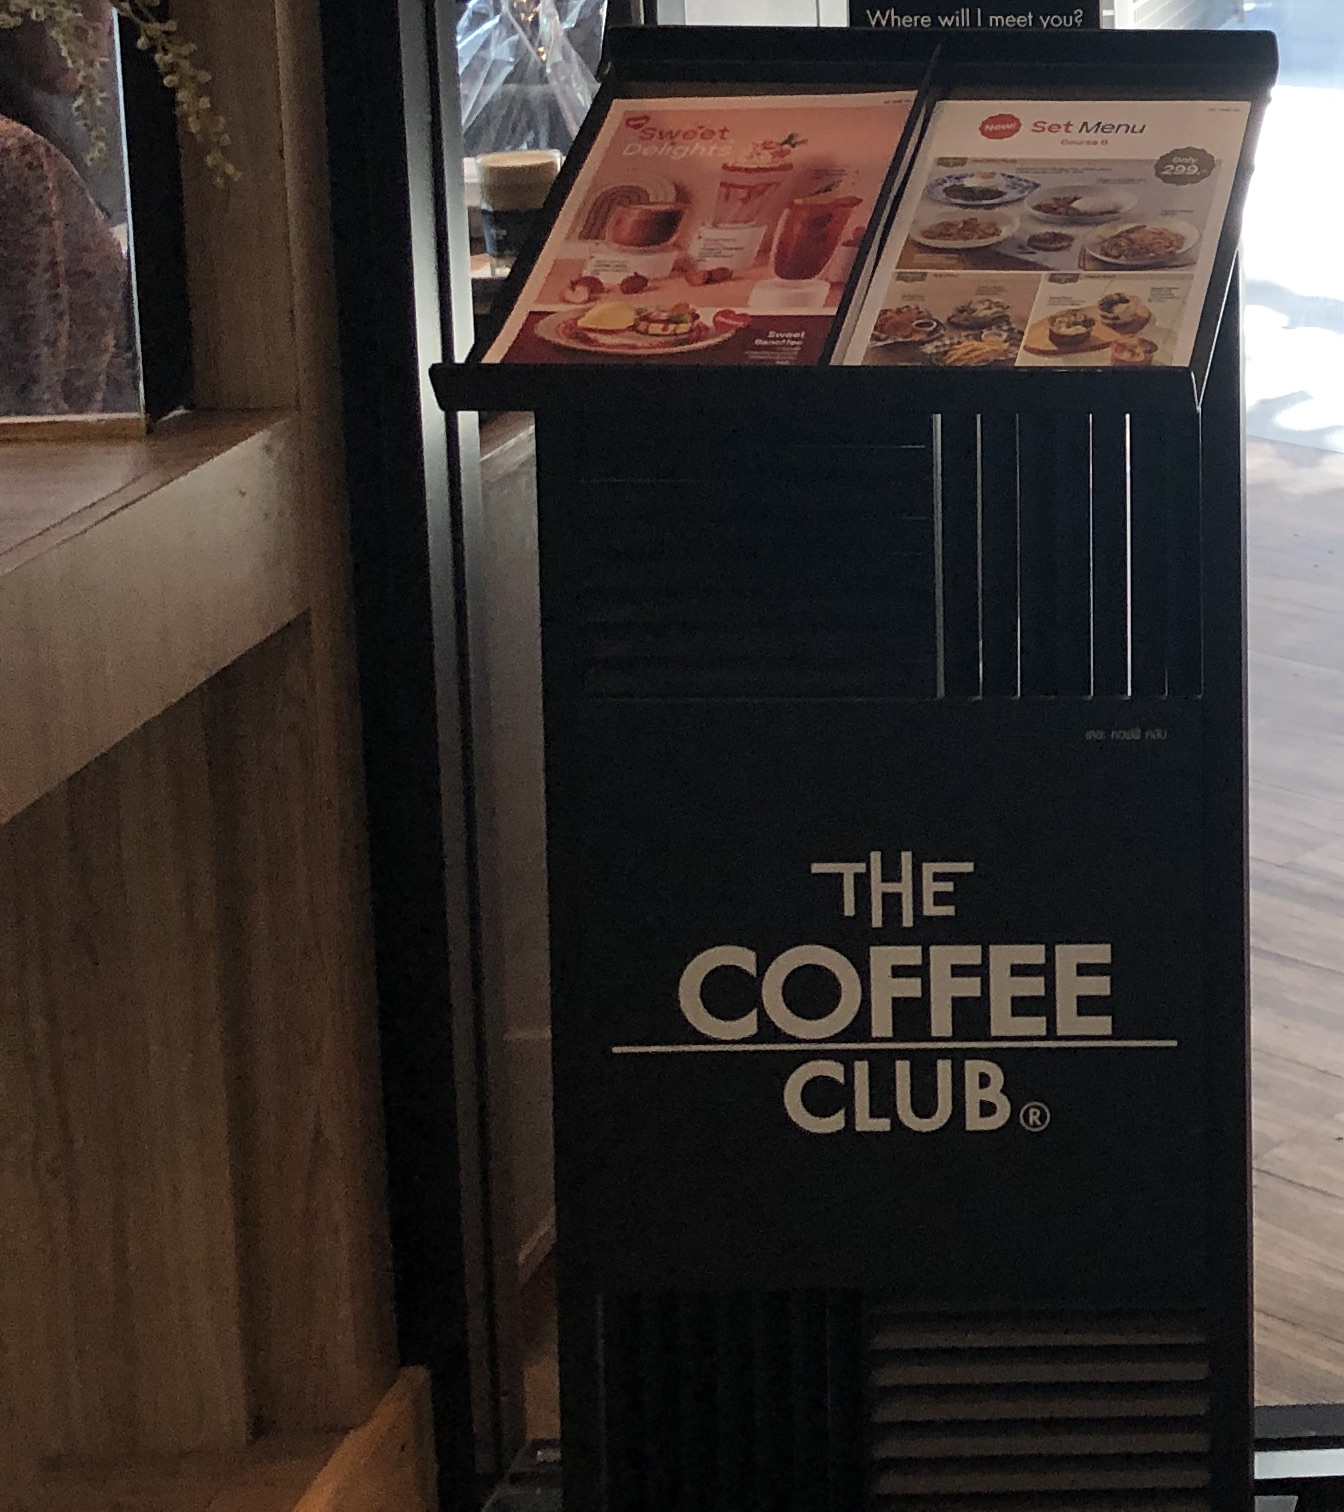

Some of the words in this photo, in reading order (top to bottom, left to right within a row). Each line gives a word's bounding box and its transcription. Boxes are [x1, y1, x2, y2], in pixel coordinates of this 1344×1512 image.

[866, 8, 931, 29] Where
[937, 8, 971, 28] will
[975, 9, 981, 28] I
[988, 10, 1034, 28] meet
[1039, 8, 1084, 29] you?
[638, 125, 730, 141] Sweet
[1030, 120, 1074, 134] Set
[1078, 121, 1147, 134] Menu
[623, 142, 732, 161] Delights
[1172, 156, 1198, 165] Only
[810, 850, 975, 928] THE
[677, 942, 1113, 1041] COFFEE
